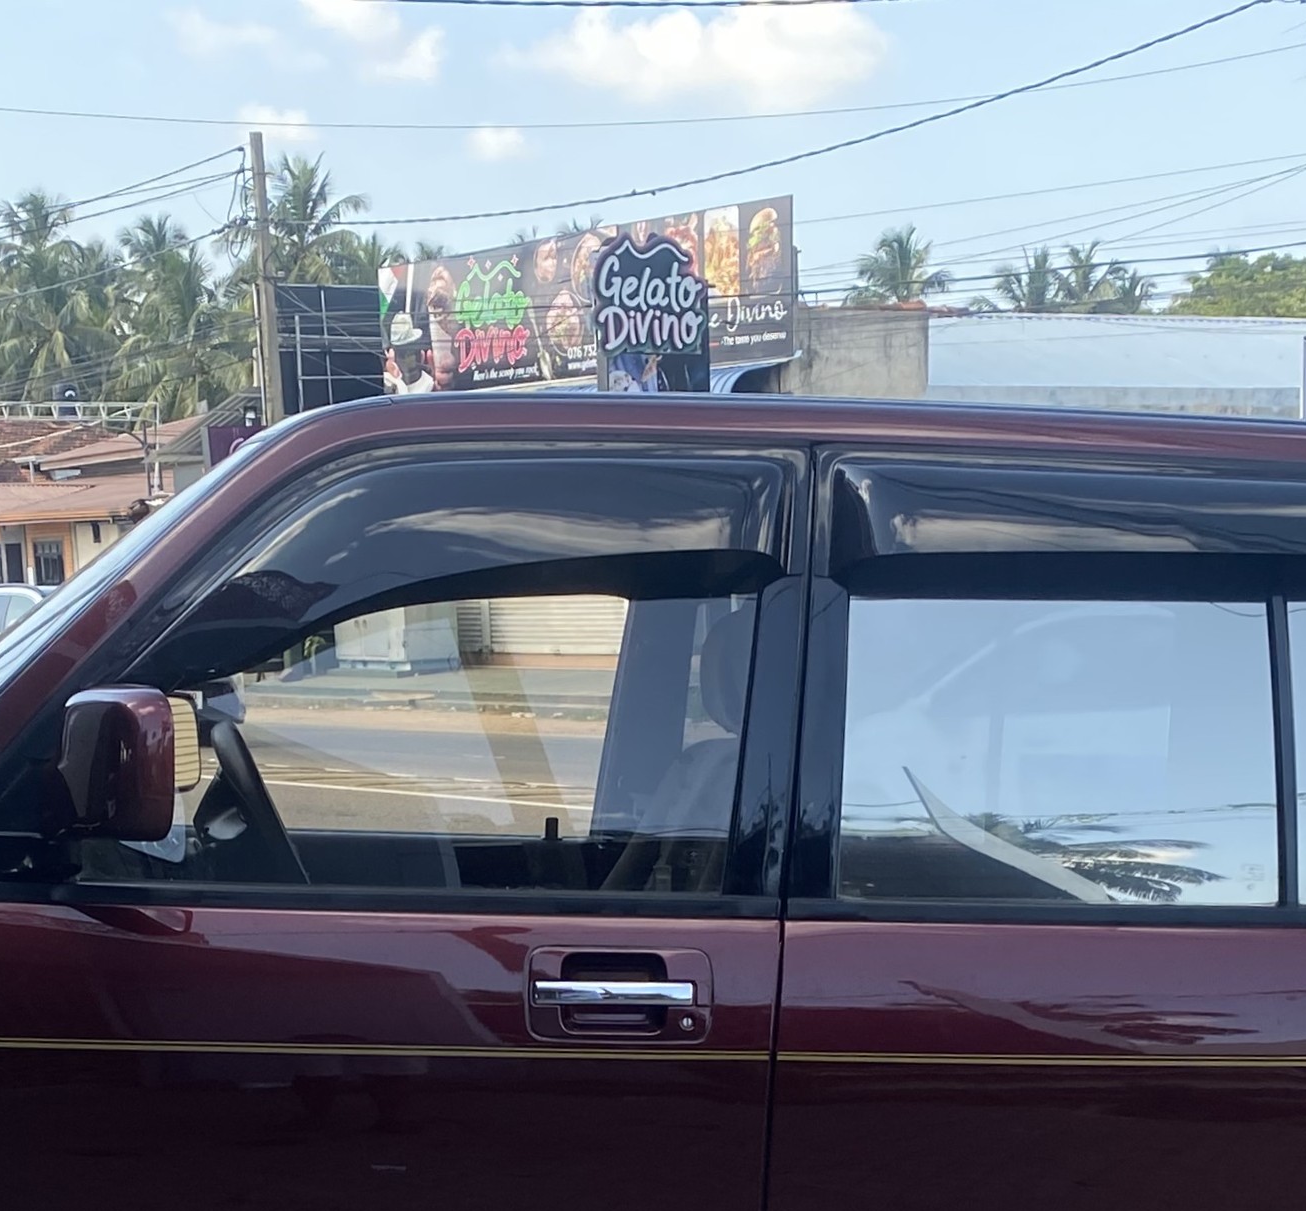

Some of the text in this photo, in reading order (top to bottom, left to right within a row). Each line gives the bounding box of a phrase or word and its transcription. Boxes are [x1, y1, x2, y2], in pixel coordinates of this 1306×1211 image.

[455, 278, 531, 330] Gelato
[598, 254, 702, 312] Gelato
[597, 305, 703, 350] Divino
